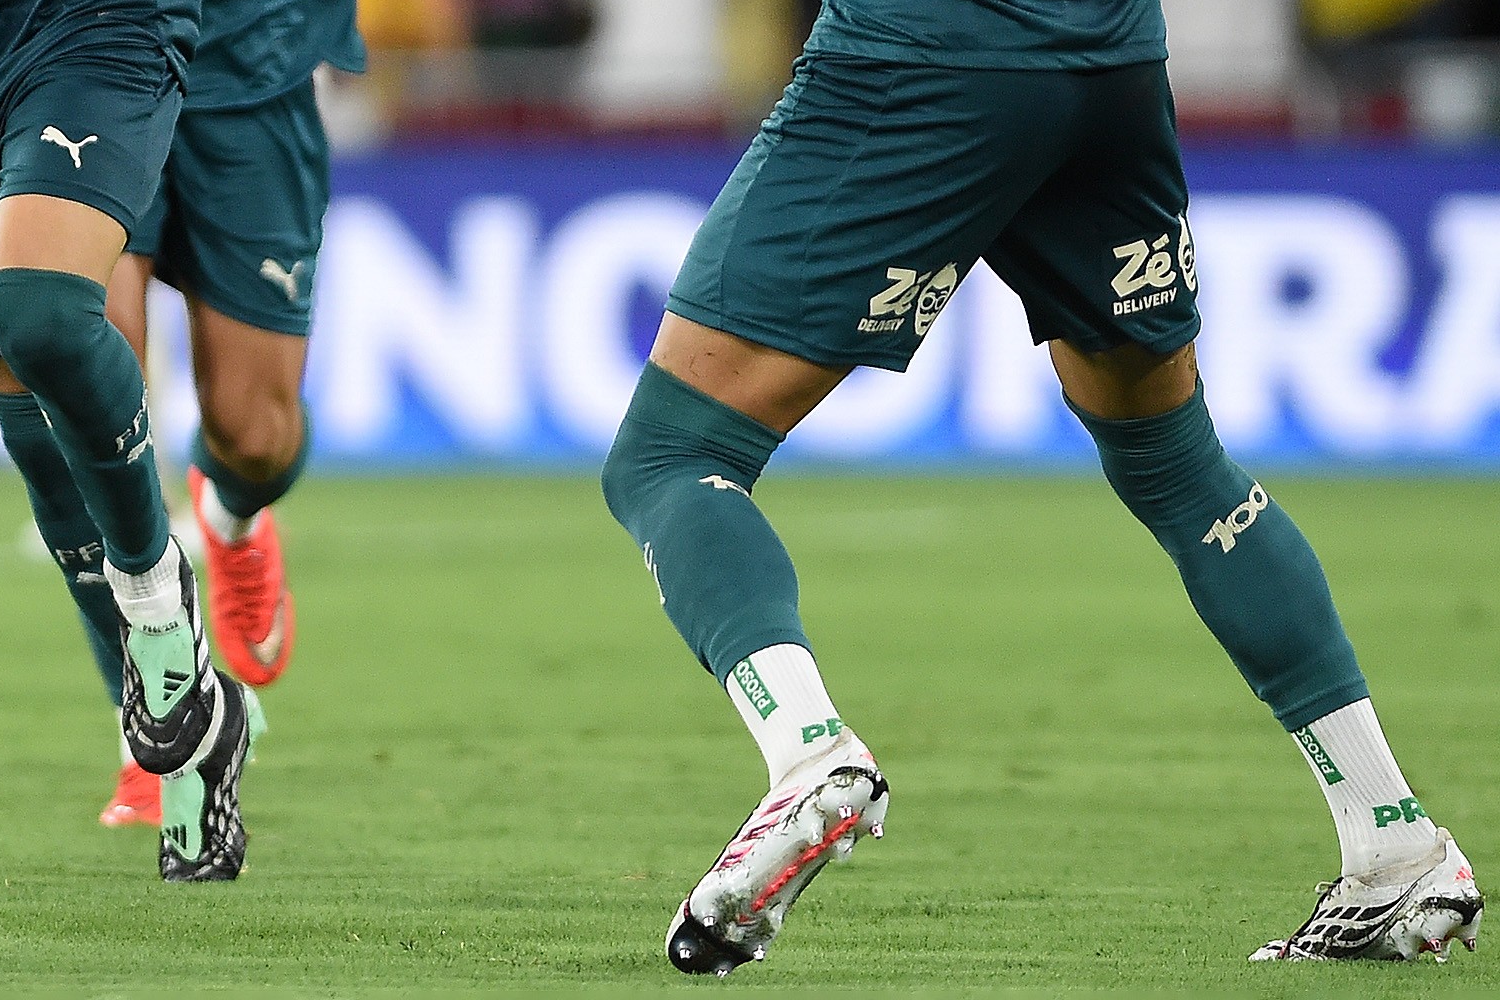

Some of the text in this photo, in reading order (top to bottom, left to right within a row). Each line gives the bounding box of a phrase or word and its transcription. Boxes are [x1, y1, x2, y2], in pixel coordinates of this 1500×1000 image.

[1110, 233, 1178, 298] Zé
[870, 267, 932, 316] Zé
[1113, 287, 1178, 316] DELIVERY
